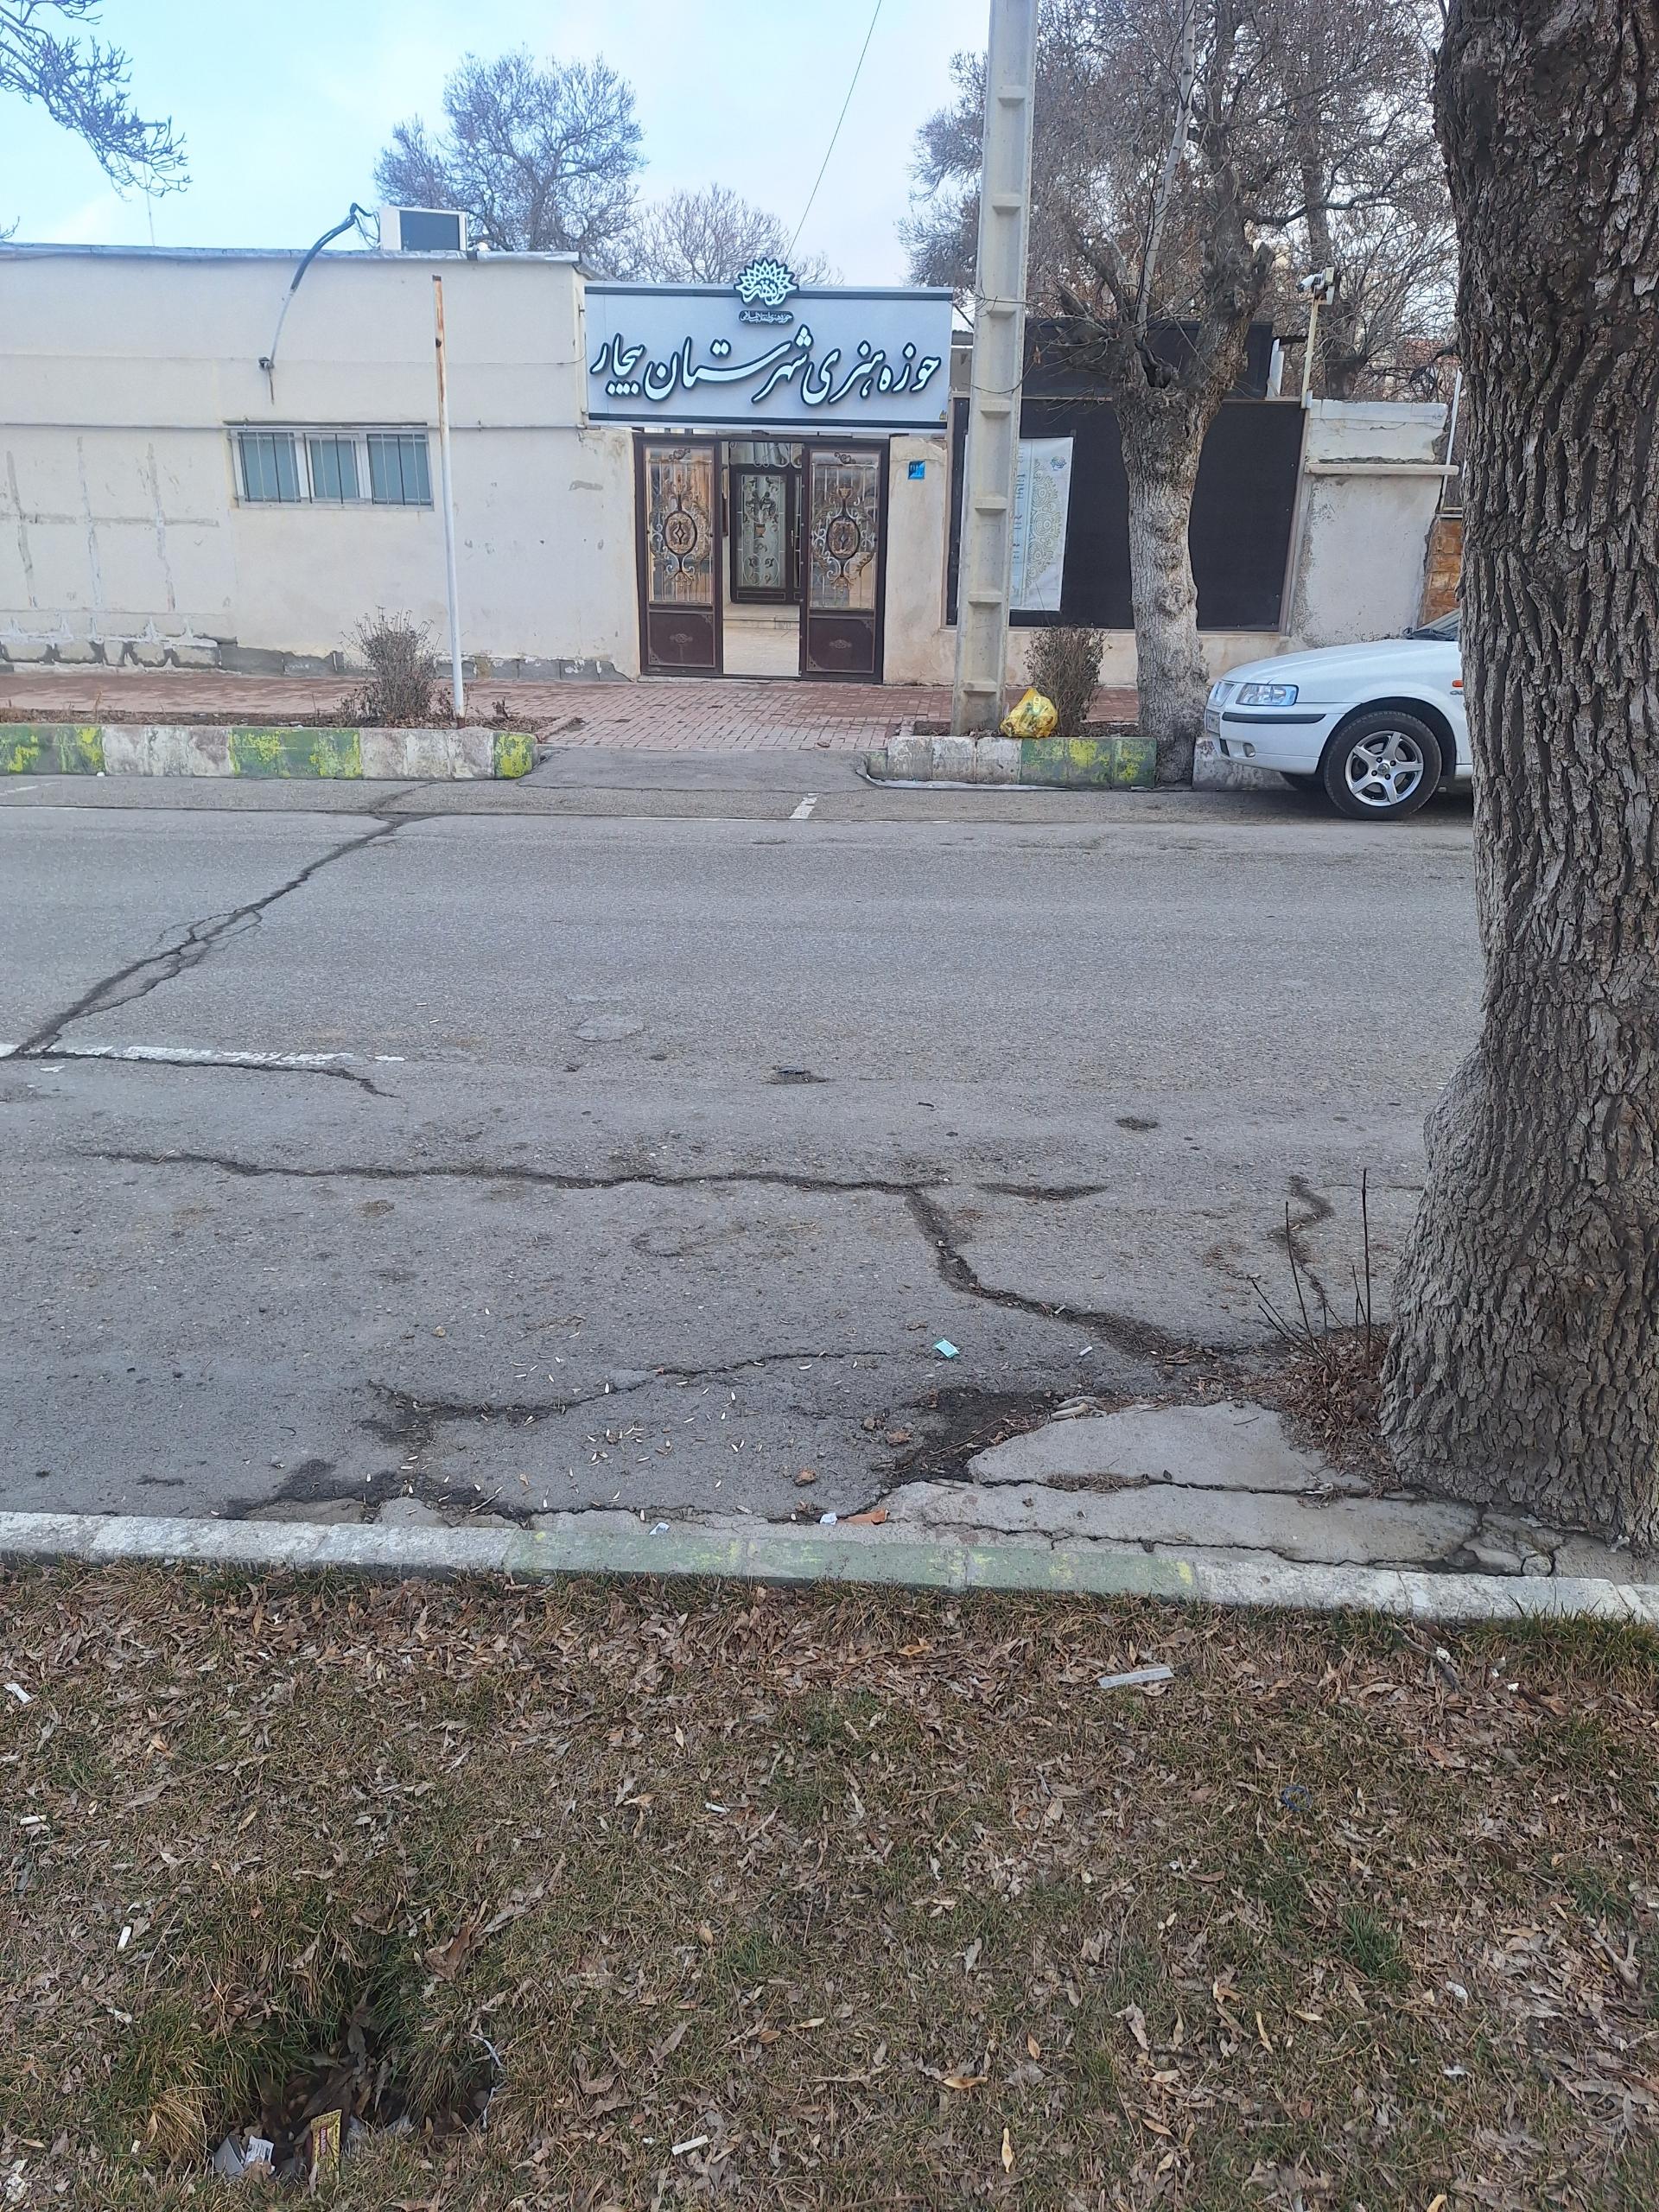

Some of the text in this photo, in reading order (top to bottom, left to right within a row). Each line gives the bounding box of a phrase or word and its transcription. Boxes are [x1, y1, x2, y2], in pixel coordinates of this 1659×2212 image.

[589, 324, 942, 405] حوزه هنری شهرستان بیجار
